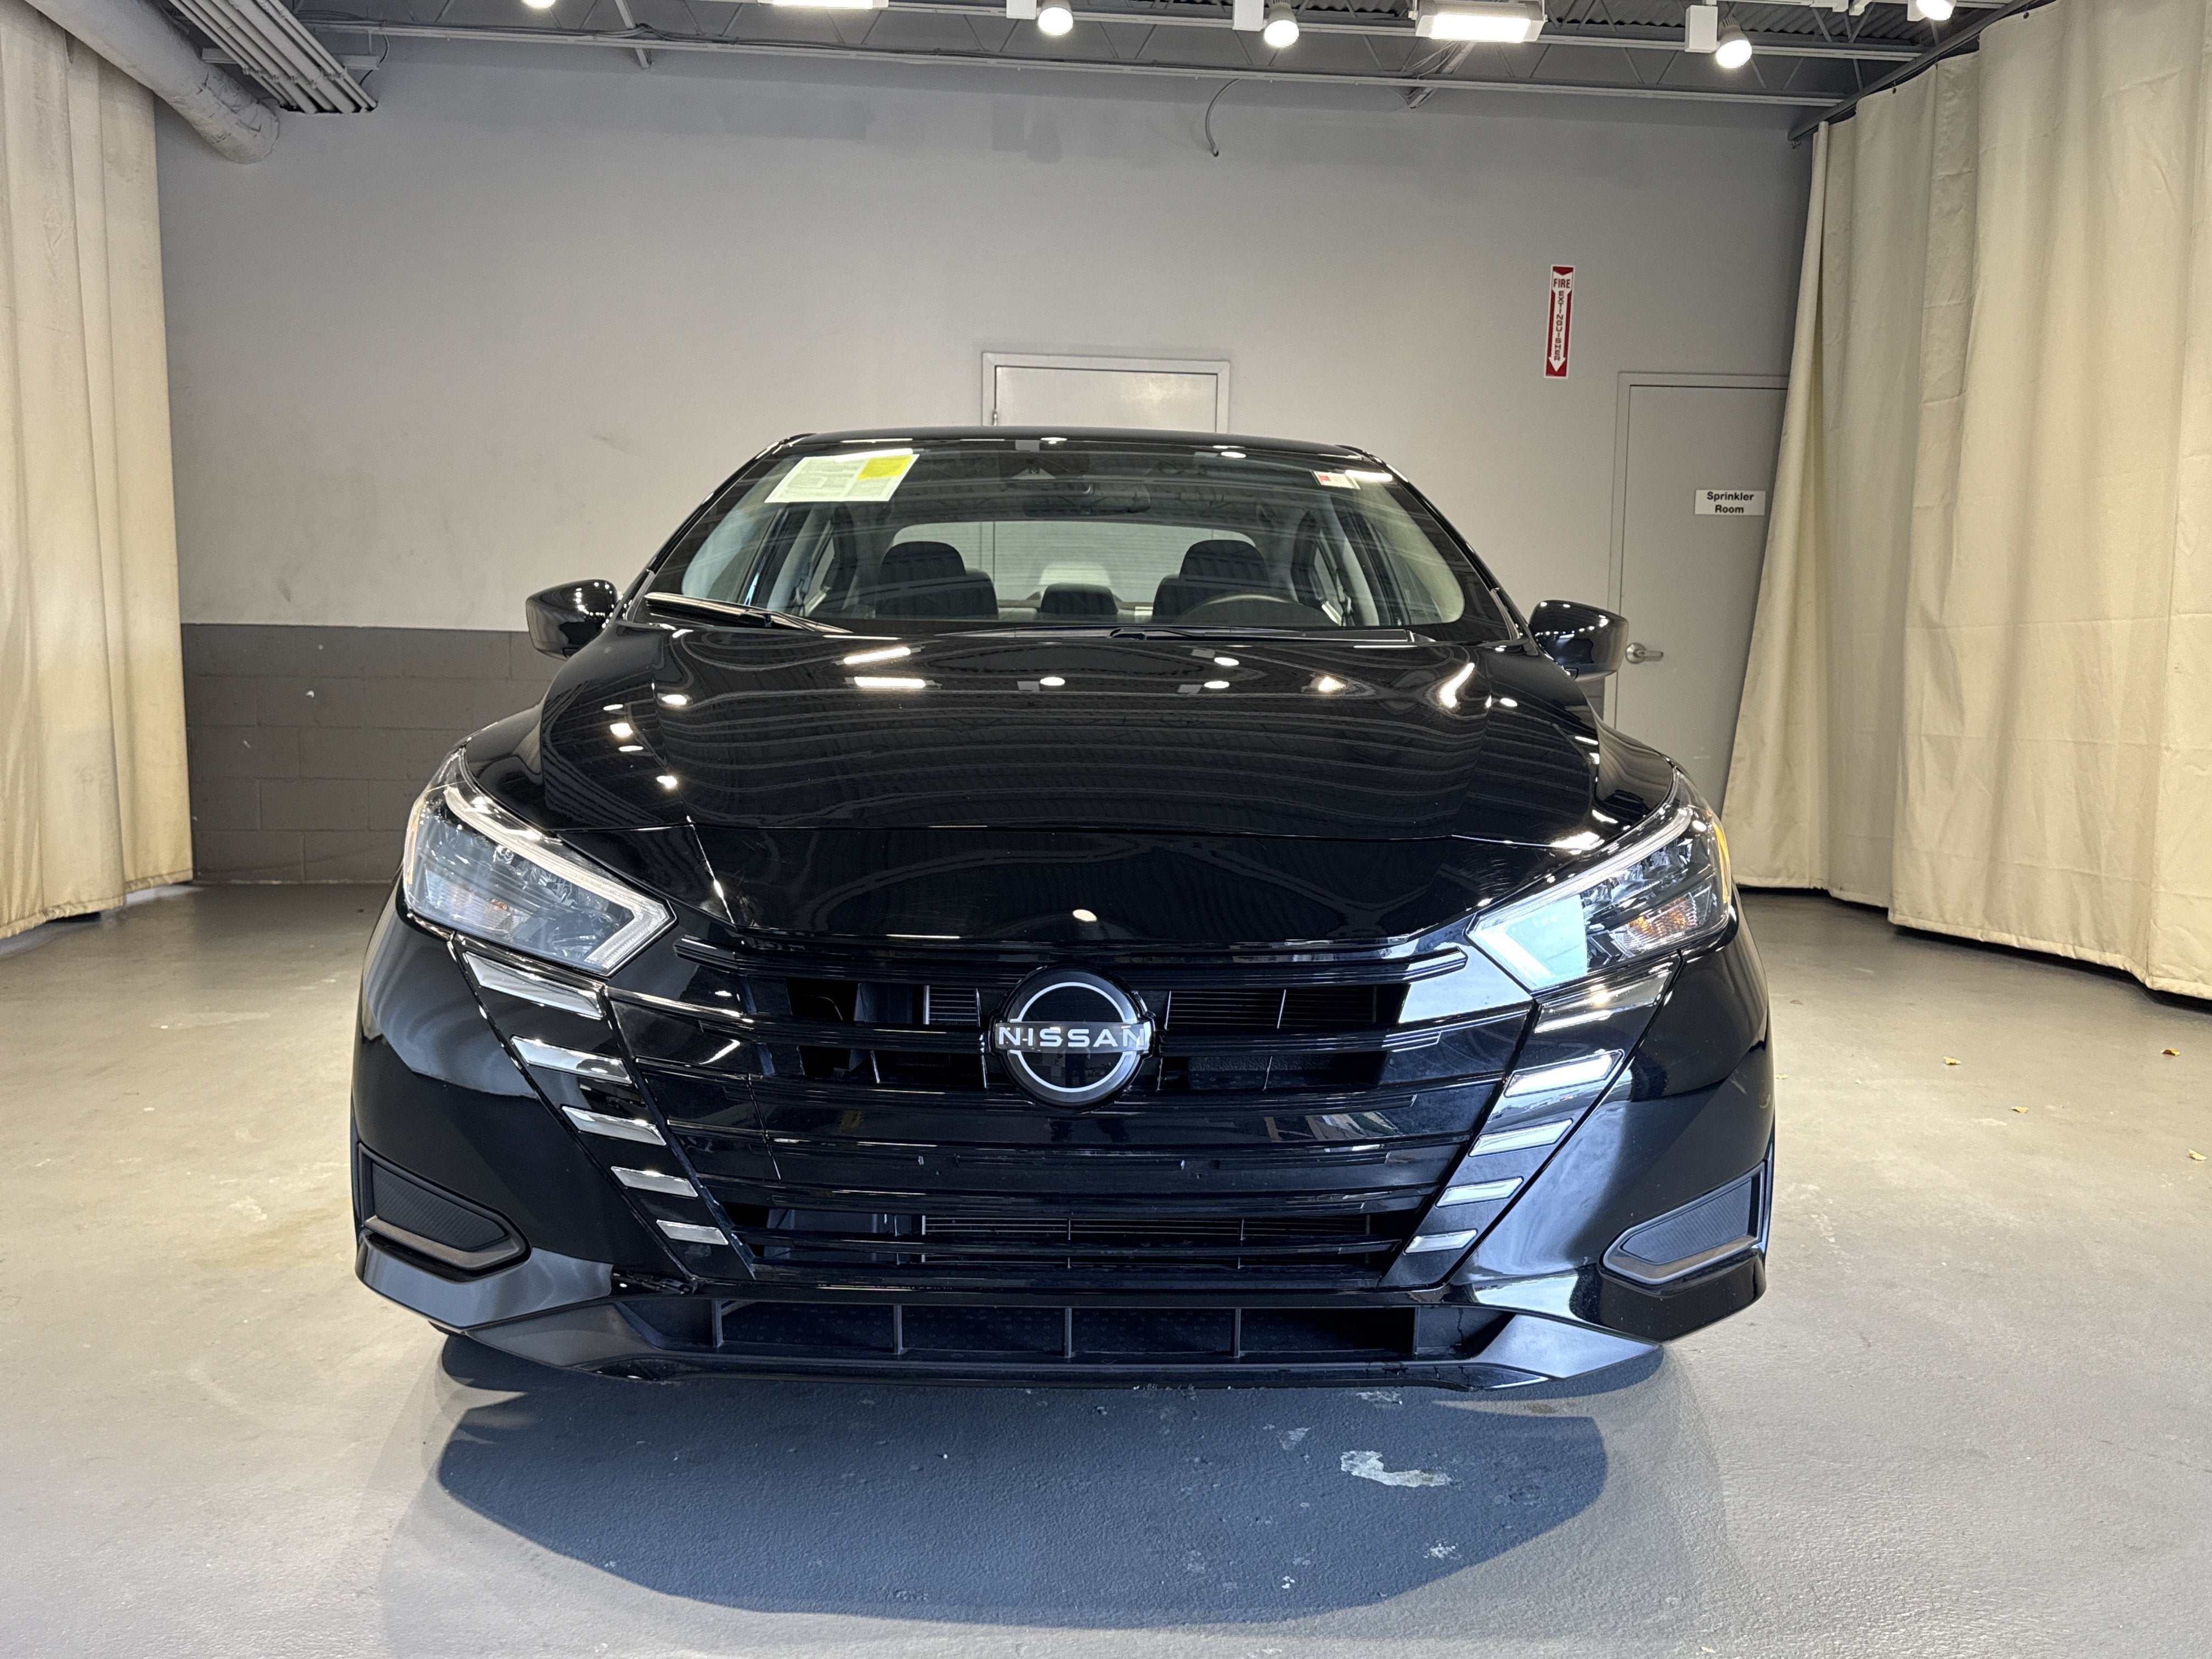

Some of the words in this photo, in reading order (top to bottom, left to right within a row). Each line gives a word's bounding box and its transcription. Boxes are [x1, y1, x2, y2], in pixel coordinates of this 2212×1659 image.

[1553, 278, 1571, 289] FIRE
[1554, 290, 1565, 362] EXTINGUISHER
[1707, 492, 1754, 501] Sprinkler
[1715, 504, 1744, 514] Room
[998, 1026, 1145, 1047] NISSAN
